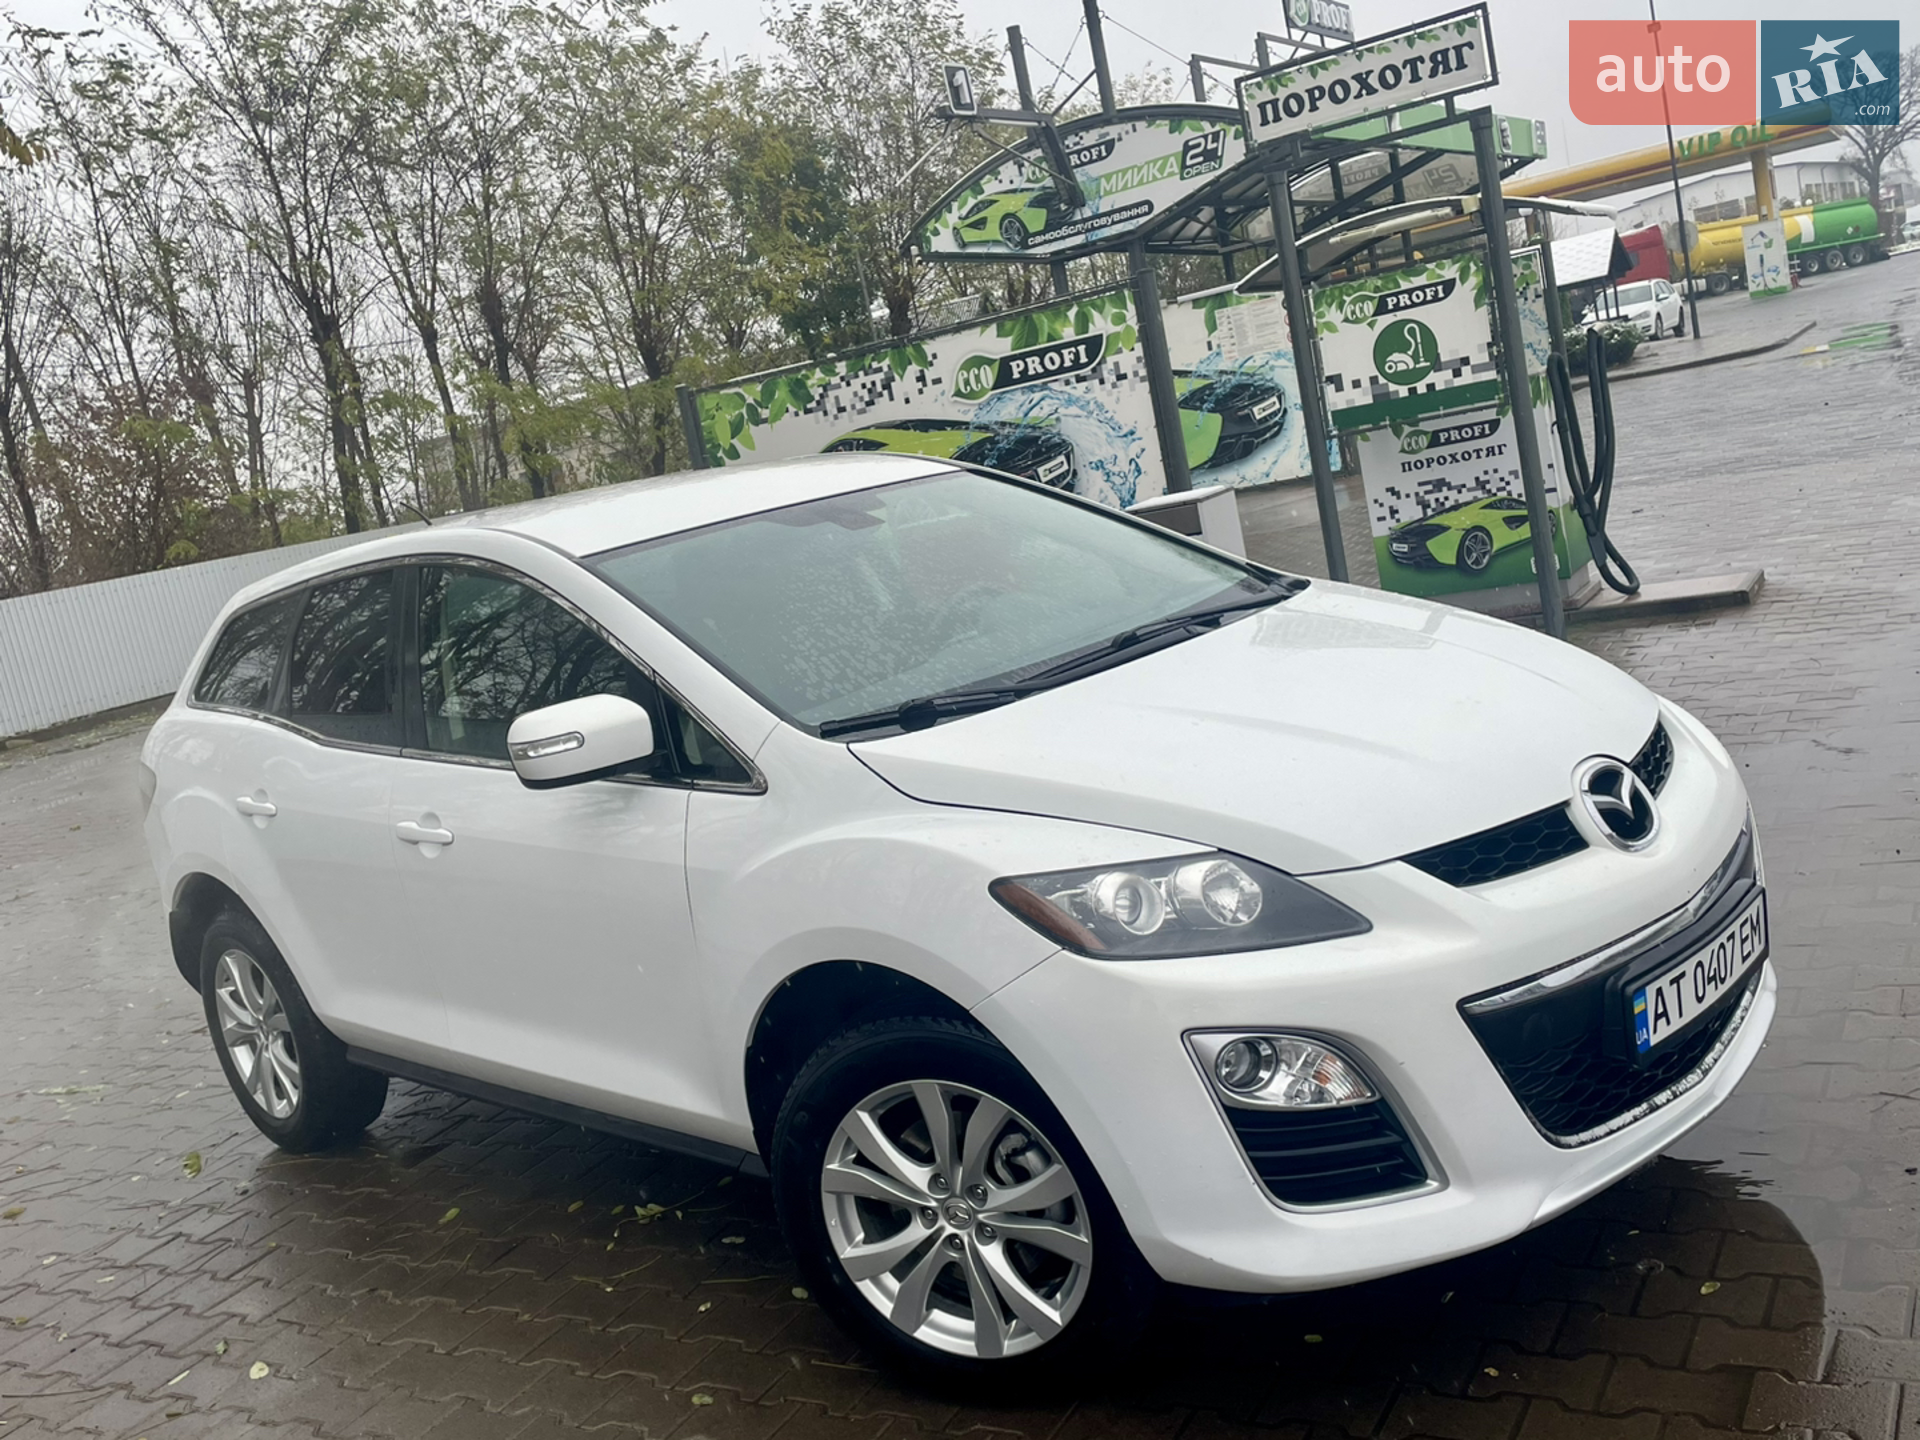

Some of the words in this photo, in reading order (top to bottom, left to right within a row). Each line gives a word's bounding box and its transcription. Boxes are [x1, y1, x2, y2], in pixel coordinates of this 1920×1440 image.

[953, 70, 971, 104] 1
[1256, 41, 1475, 127] ПОРОХОТЯГ
[1069, 145, 1107, 166] ROFI
[1185, 130, 1225, 166] 24
[1677, 131, 1722, 160] VIP
[1100, 155, 1179, 196] МИЙКА
[1183, 159, 1220, 179] OPEN
[1028, 204, 1149, 245] самообслуговування
[1386, 285, 1445, 310] PROFI
[1009, 344, 1089, 379] PROFI
[1438, 423, 1492, 443] PROFI
[1400, 443, 1508, 473] ПОРОХОТЯГ
[1653, 970, 1686, 1035] AT
[1693, 931, 1736, 1004] 0407
[1739, 905, 1762, 965] EM
[1635, 1027, 1649, 1045] UA
